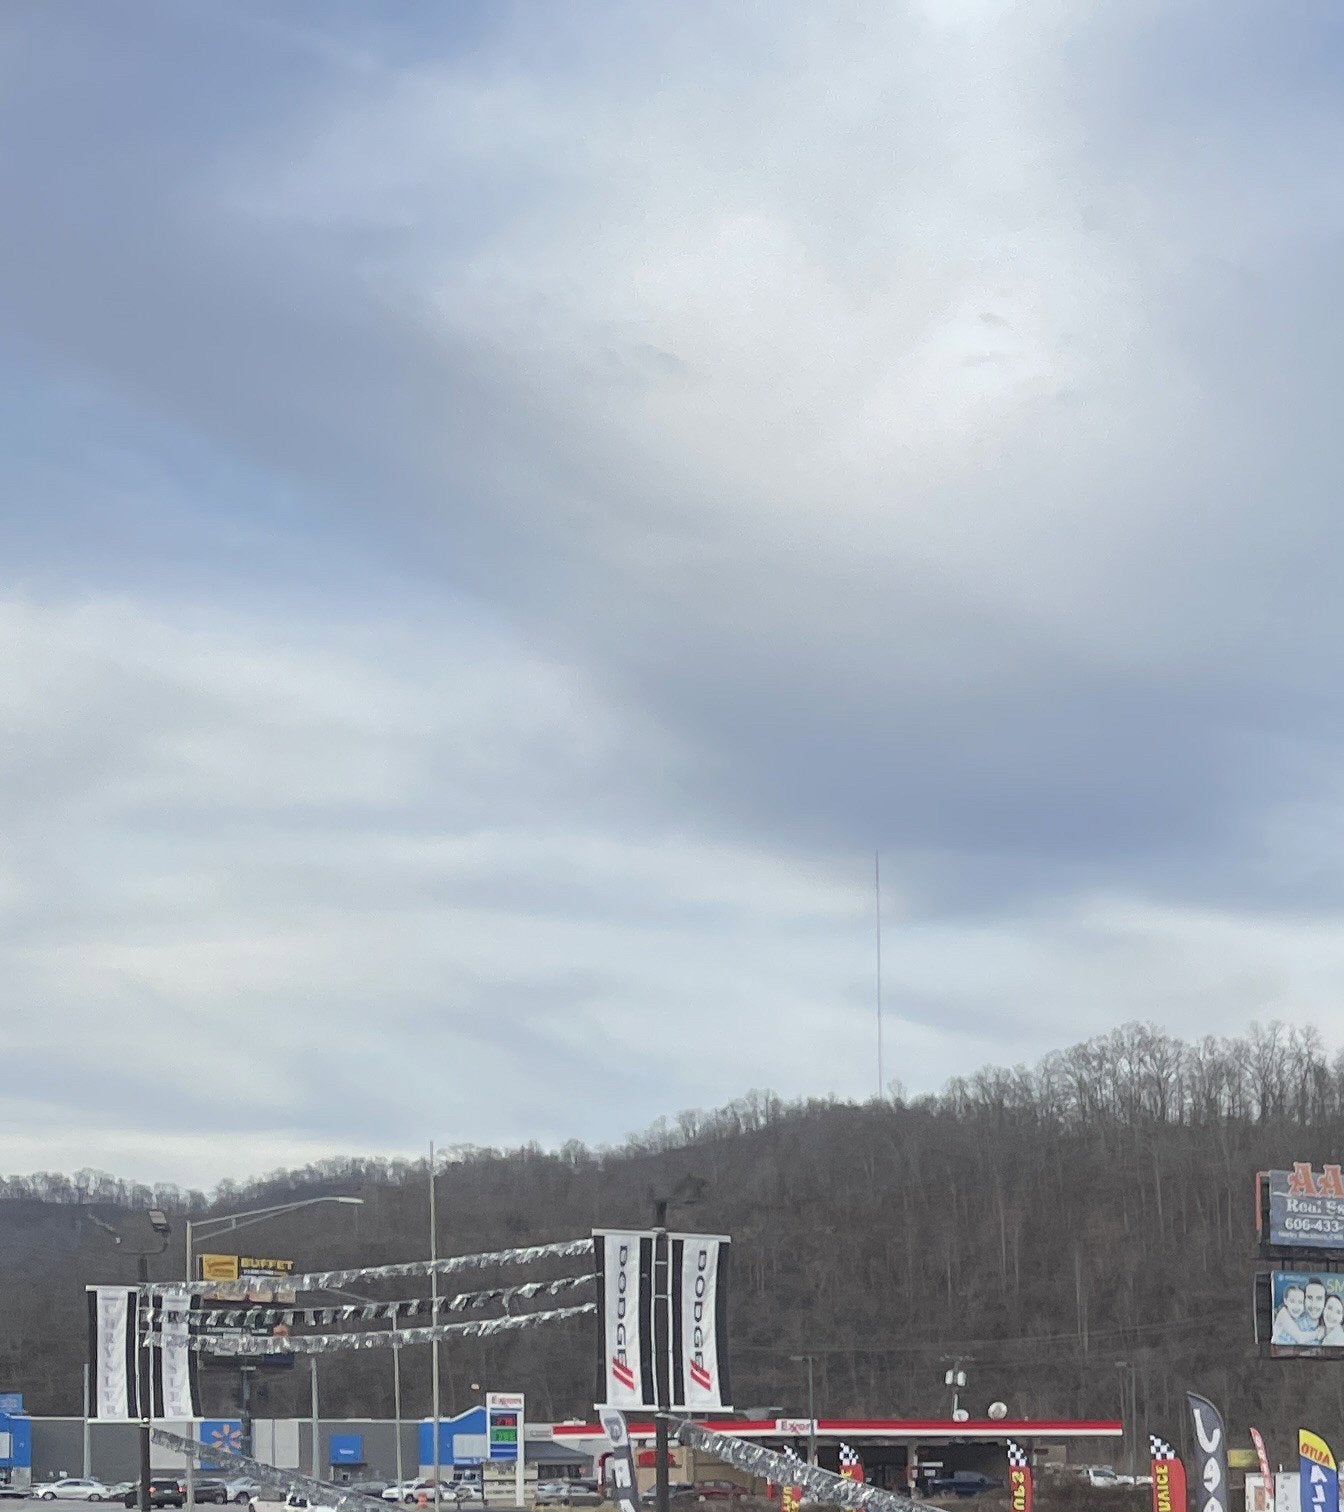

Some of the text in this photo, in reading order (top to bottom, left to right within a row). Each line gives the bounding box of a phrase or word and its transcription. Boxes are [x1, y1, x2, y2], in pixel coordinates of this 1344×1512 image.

[1286, 1199, 1321, 1214] Real
[240, 1257, 294, 1270] BUFFET
[616, 1245, 628, 1368] DODGE
[694, 1250, 707, 1370] DODGE
